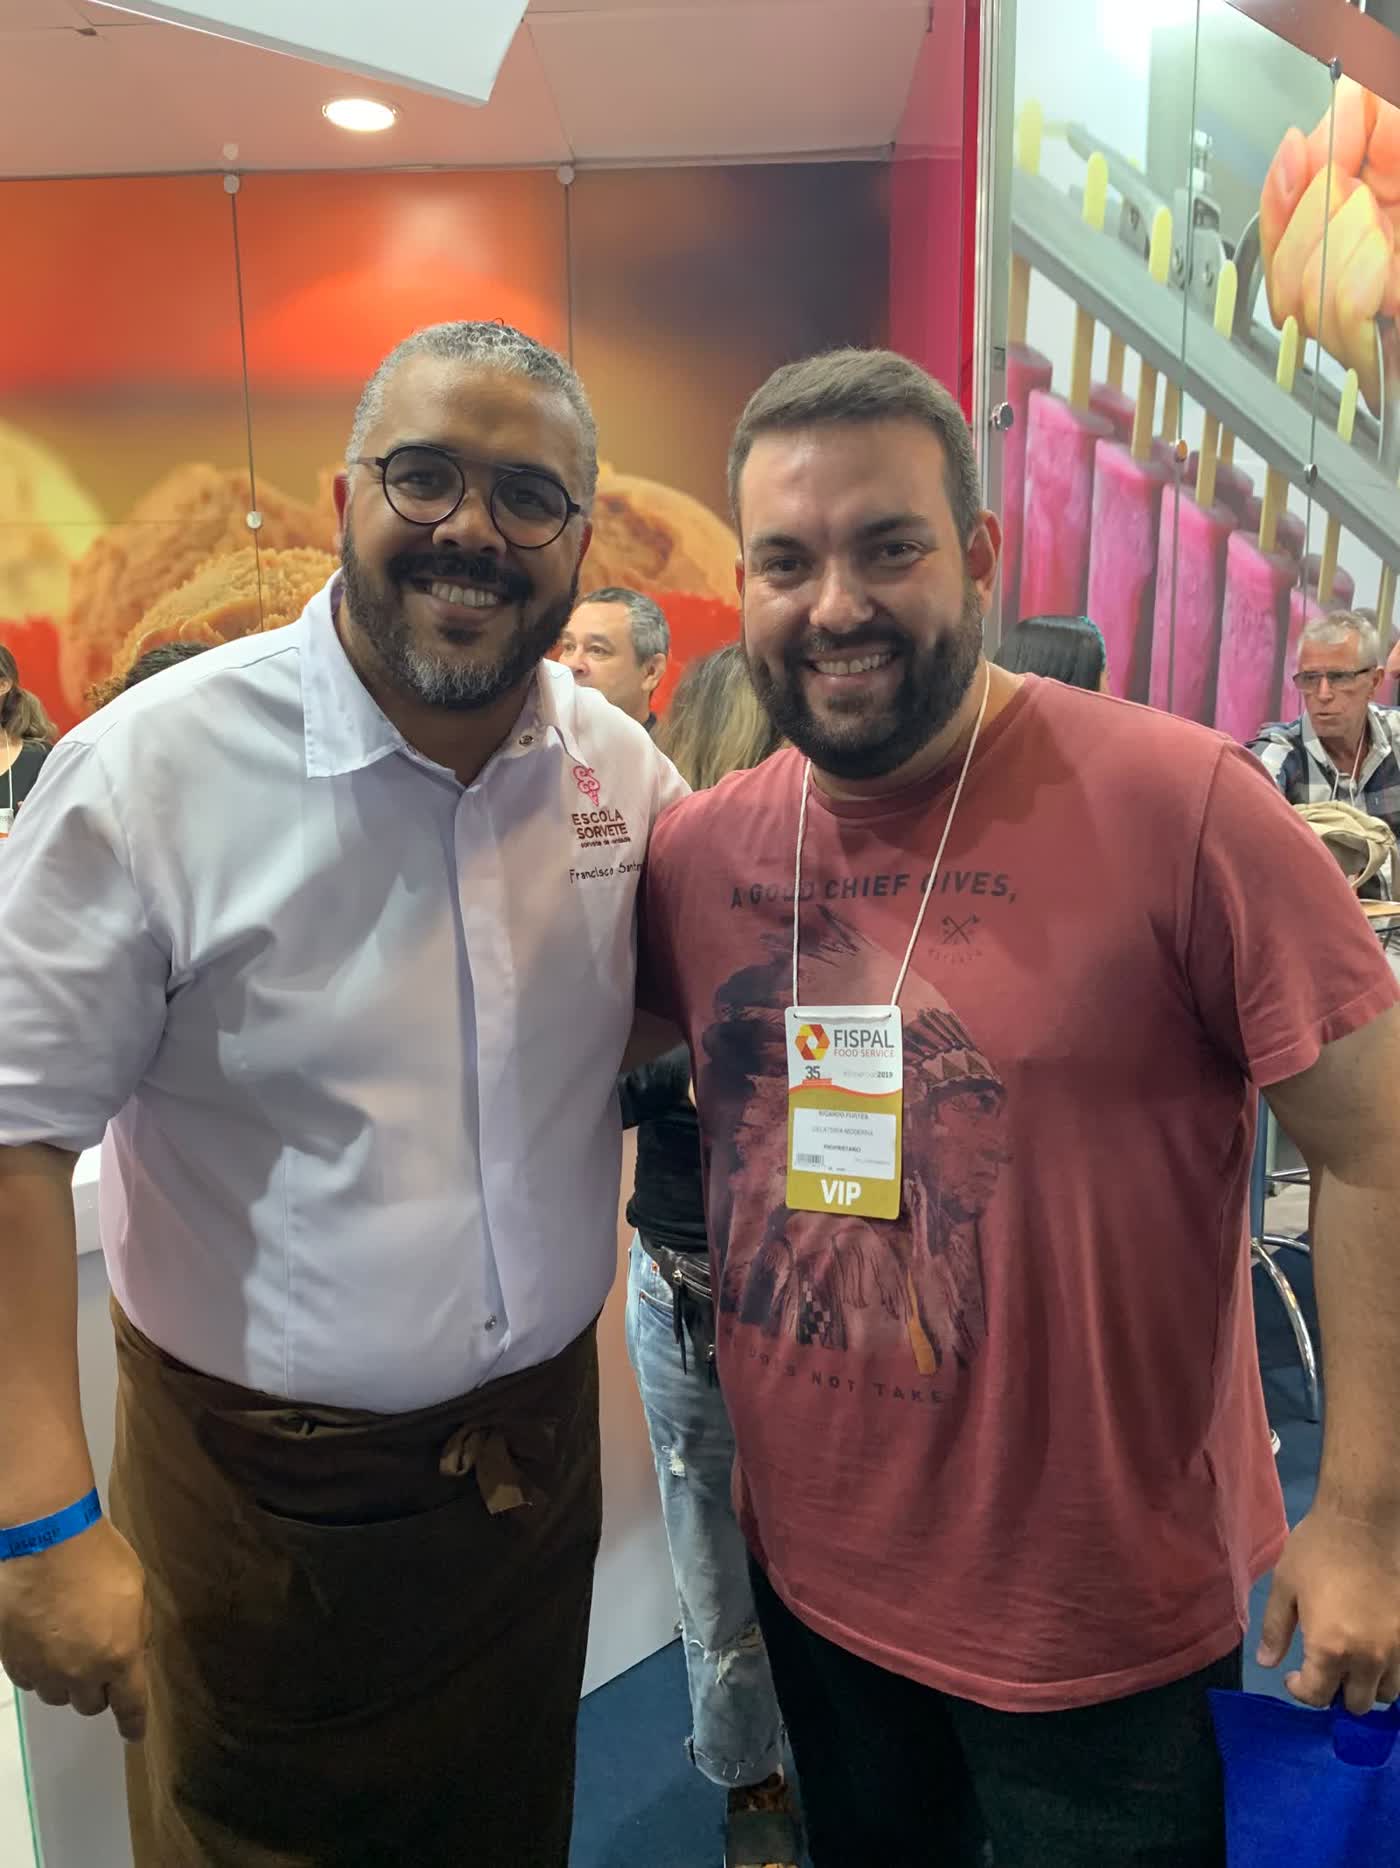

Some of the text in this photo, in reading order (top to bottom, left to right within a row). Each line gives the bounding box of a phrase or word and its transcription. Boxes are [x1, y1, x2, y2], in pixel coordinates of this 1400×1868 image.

[571, 808, 624, 826] ESCOLA
[576, 822, 628, 840] SORVETE
[569, 866, 614, 884] Francisco
[730, 886, 743, 909] A
[824, 873, 910, 900] CHIEF
[833, 1029, 895, 1049] FISPAL
[834, 1048, 895, 1058] FOOD SERVICE
[804, 1065, 821, 1080] 35
[821, 1179, 861, 1206] VIP
[812, 1370, 855, 1393] NOT
[873, 1382, 944, 1402] TAKE
